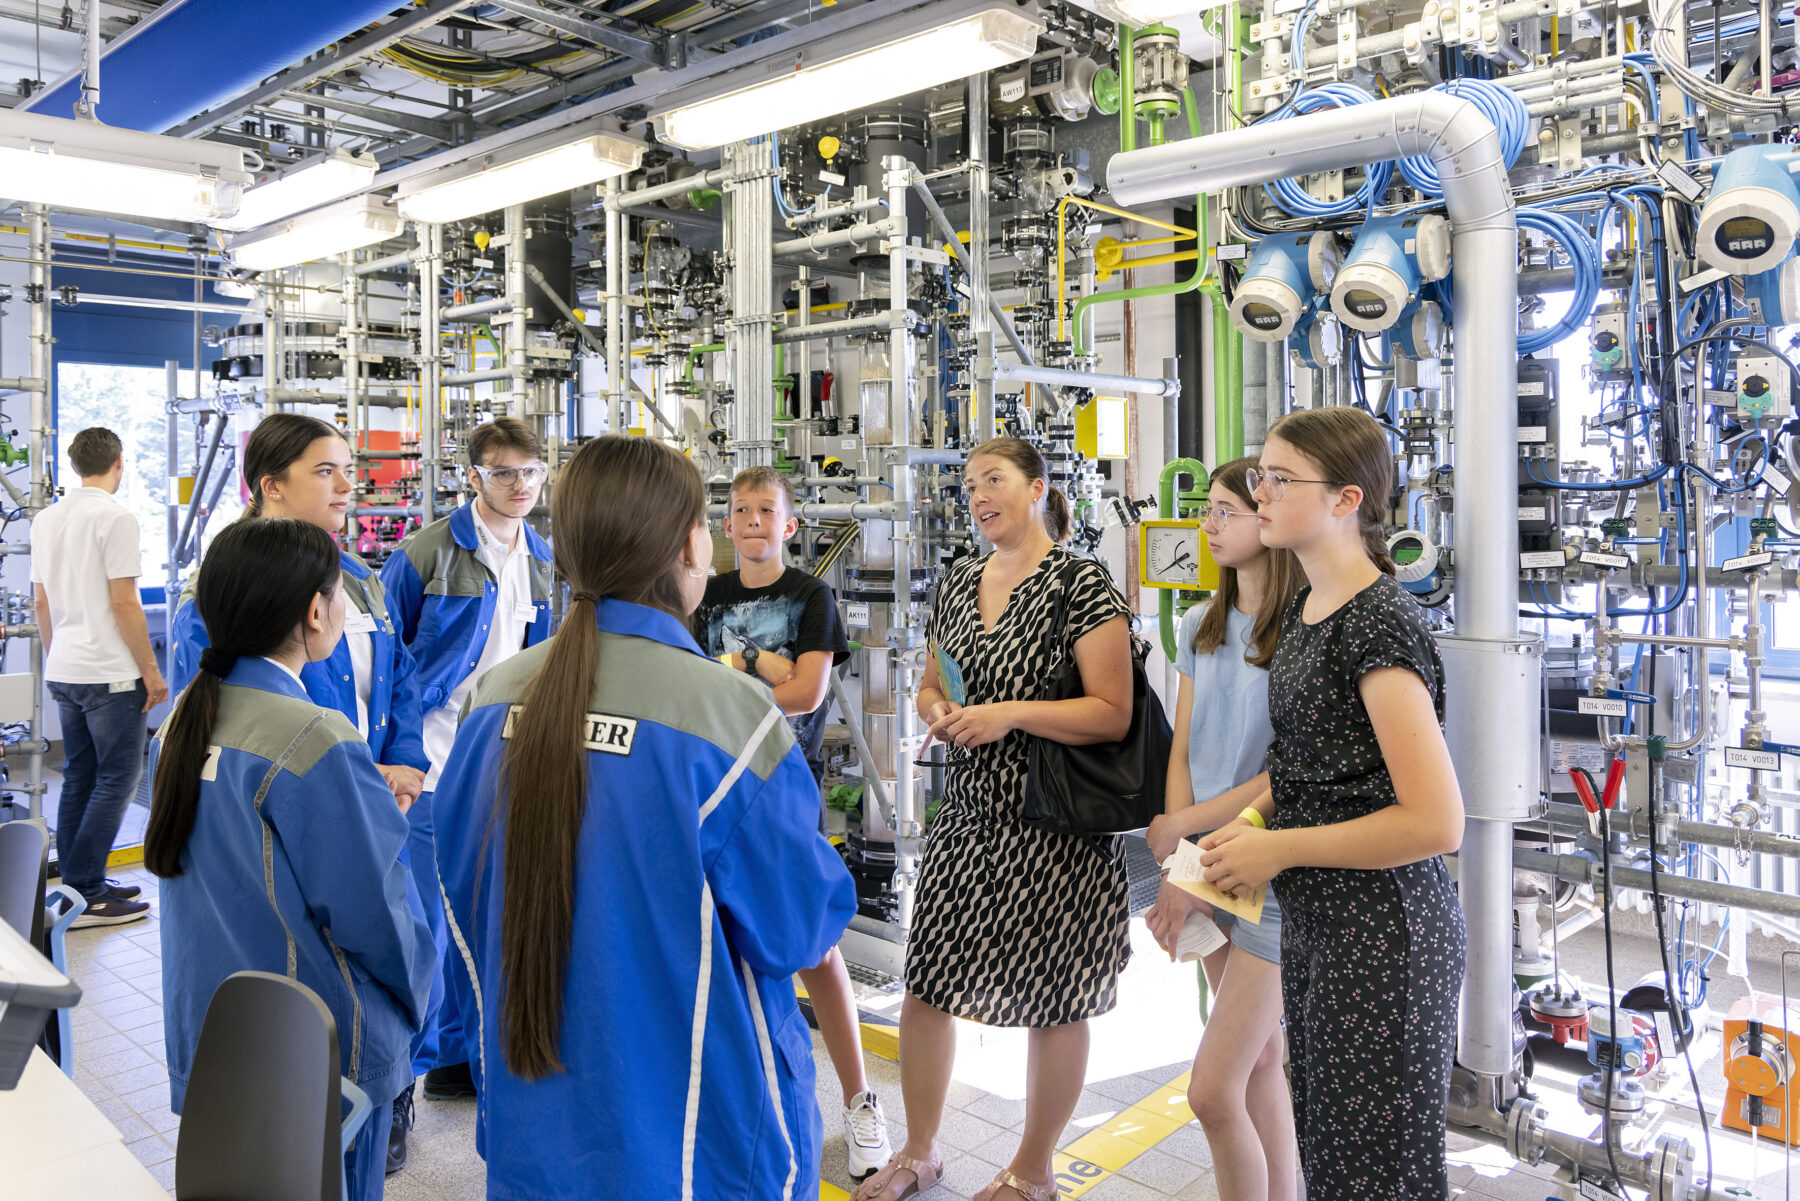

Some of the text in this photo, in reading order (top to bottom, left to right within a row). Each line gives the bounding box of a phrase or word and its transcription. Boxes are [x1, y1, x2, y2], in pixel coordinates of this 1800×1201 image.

[1002, 86, 1023, 97] AW113
[1582, 701, 1623, 712] T014 V0010
[1731, 754, 1775, 765] T014 V0013
